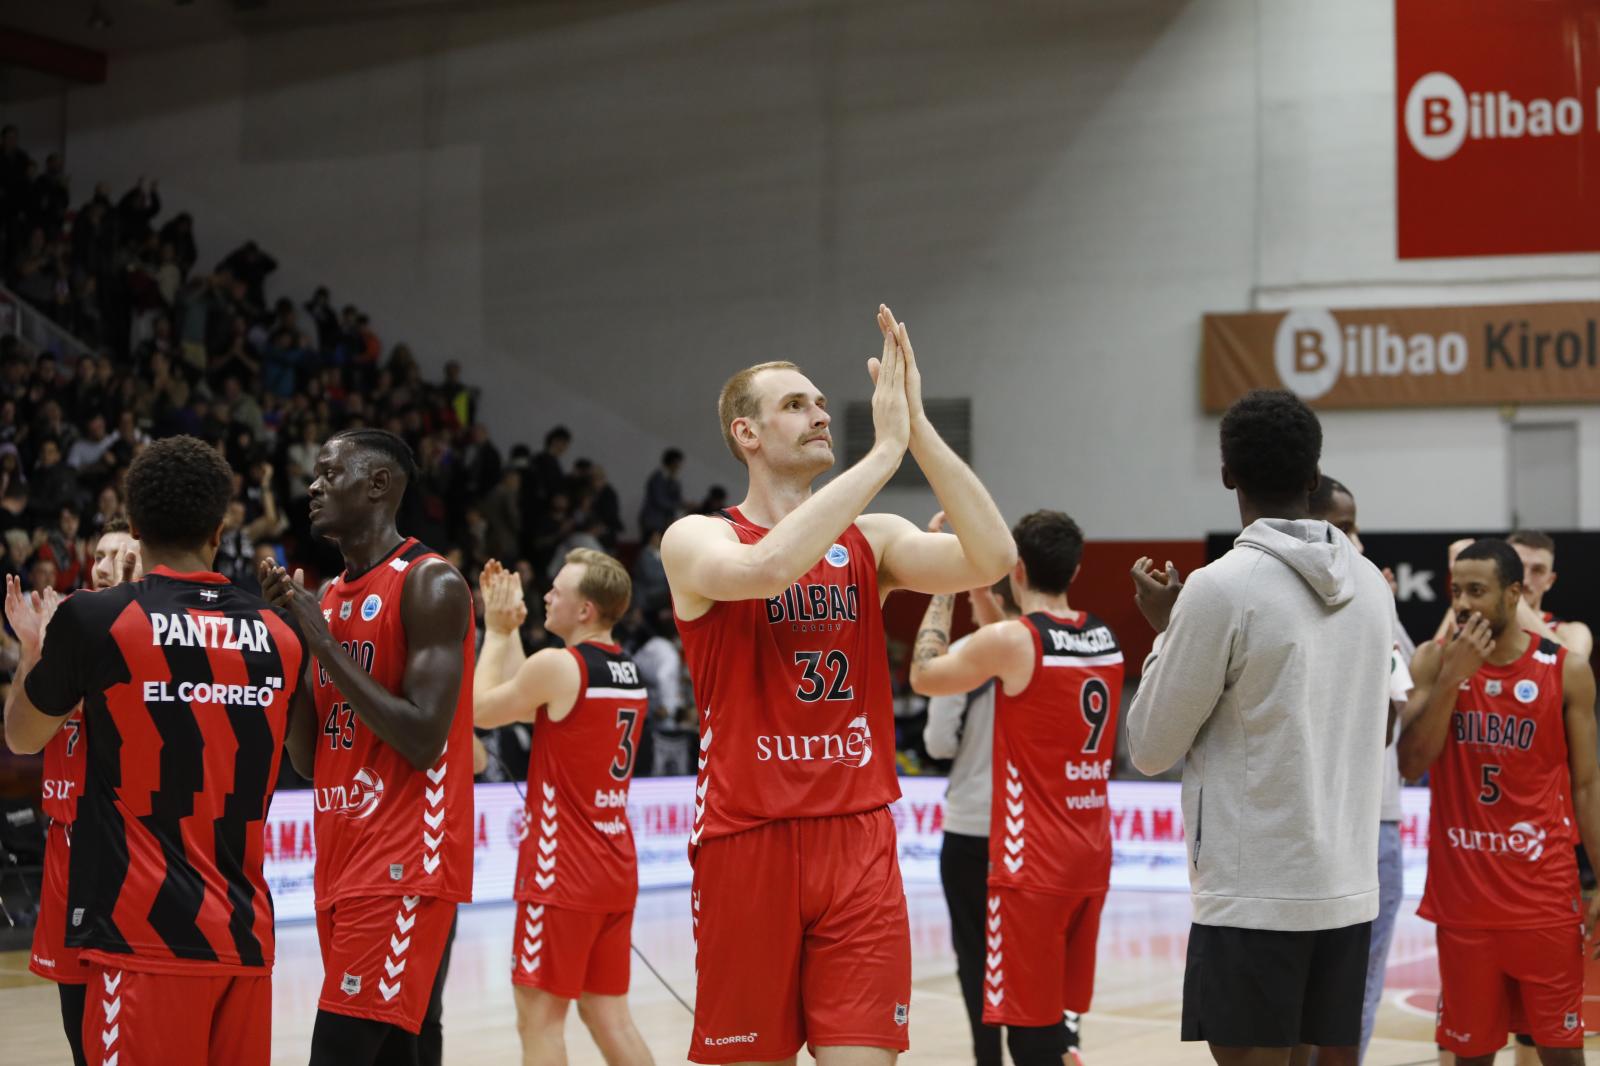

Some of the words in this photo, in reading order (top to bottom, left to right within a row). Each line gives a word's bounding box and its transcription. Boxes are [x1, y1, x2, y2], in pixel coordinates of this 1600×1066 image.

[1421, 90, 1583, 140] Bilbao
[1291, 324, 1468, 378] Bilbao
[1397, 563, 1436, 601] k
[765, 583, 857, 624] BILBAO
[150, 612, 271, 653] PANTZAR
[607, 660, 639, 685] FREY
[794, 649, 854, 703] 32
[143, 681, 175, 702] EL
[178, 681, 274, 707] CORREO
[324, 702, 356, 750] 43
[1080, 676, 1110, 753] 9
[1453, 710, 1536, 750] BILBAO
[63, 718, 81, 757] 7
[609, 707, 639, 782] 3
[756, 731, 864, 761] surne
[42, 779, 76, 799] sur
[315, 783, 361, 812] urne
[594, 789, 627, 809] bbk
[1479, 763, 1501, 804] 5
[1111, 808, 1184, 841] YAM
[1447, 826, 1526, 854] surne
[704, 1037, 716, 1046] EL
[716, 1034, 755, 1046] CORREO
